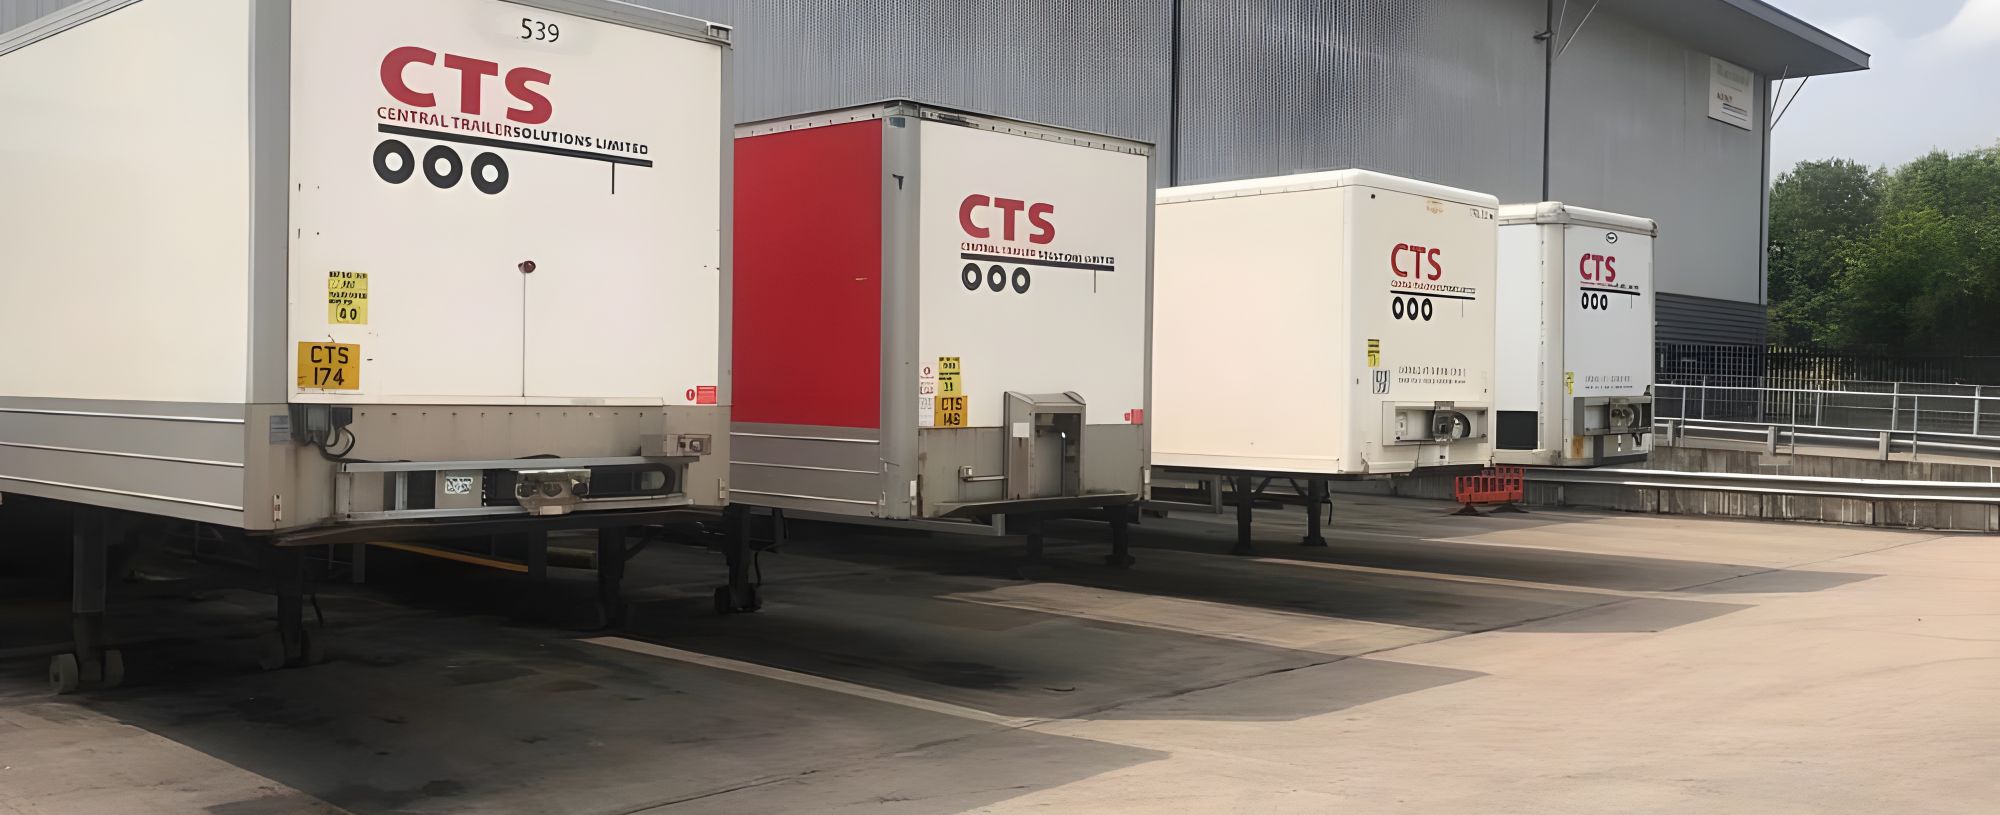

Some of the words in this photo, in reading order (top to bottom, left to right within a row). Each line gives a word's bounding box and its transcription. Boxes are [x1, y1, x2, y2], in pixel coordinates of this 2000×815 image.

[521, 17, 559, 42] 539
[380, 46, 553, 125] CTS
[377, 106, 448, 128] CENTRAL
[958, 194, 1056, 245] CTS
[1390, 243, 1443, 281] CTS
[1579, 253, 1616, 283] CTS
[310, 345, 349, 364] CTS
[313, 367, 345, 386] 174
[941, 397, 963, 411] CTS
